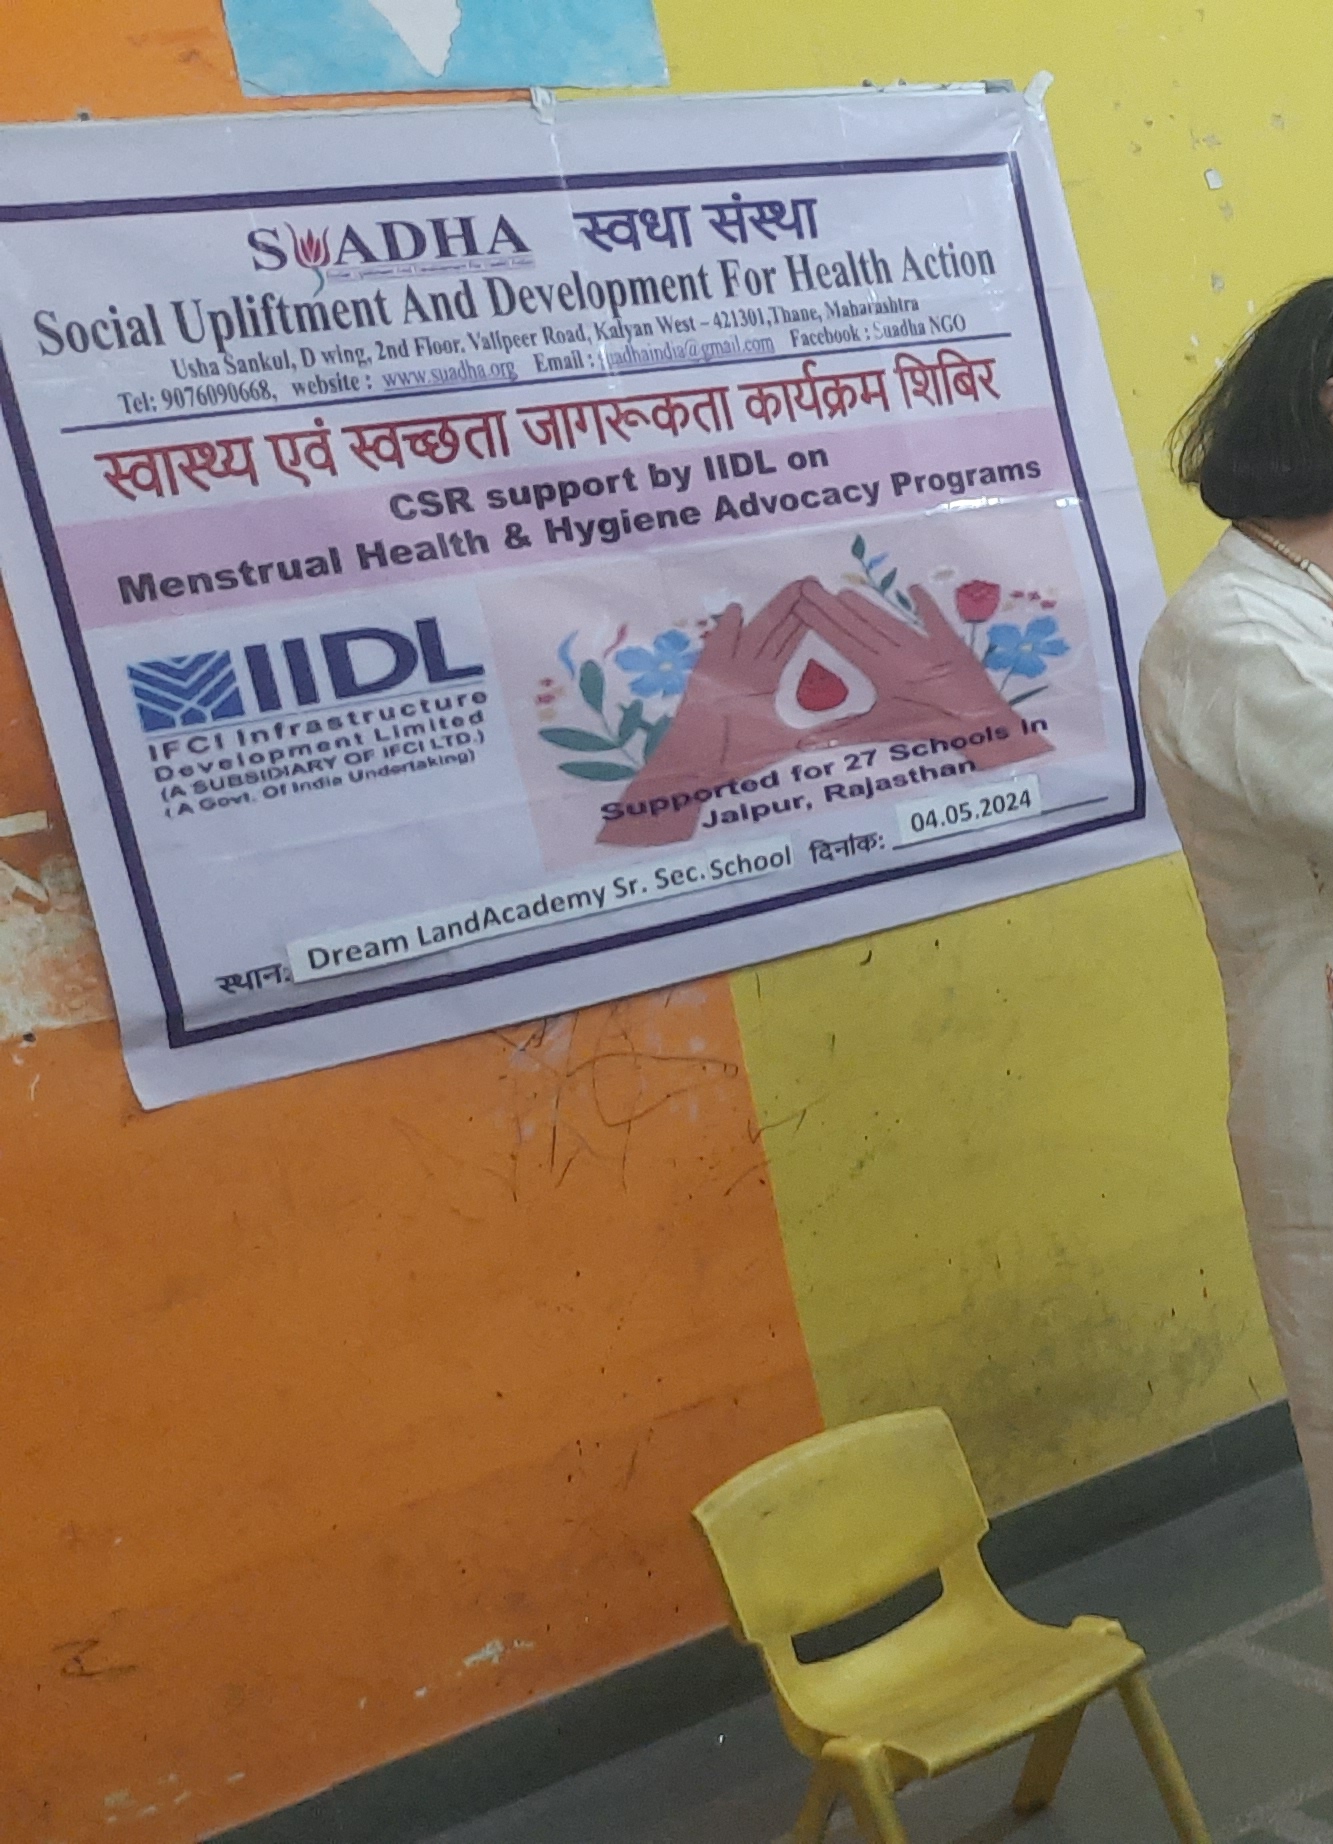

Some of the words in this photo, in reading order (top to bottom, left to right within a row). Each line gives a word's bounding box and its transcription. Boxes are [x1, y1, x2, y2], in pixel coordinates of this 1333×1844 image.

[573, 205, 692, 253] स्वधा
[701, 192, 818, 244] संस्था
[33, 303, 166, 356] Social
[170, 287, 393, 353] Upliftment
[403, 278, 479, 325] And
[483, 264, 713, 319] Development
[717, 258, 777, 298] For
[783, 248, 893, 293] Health
[902, 241, 996, 282] Action
[170, 356, 221, 380] Usha
[223, 349, 297, 376] Sankul,
[300, 347, 316, 368] D
[320, 344, 373, 369] wing,
[374, 338, 410, 361] 2nd
[541, 322, 593, 345] Road,
[593, 318, 654, 343] Kalyan
[655, 314, 697, 334] West
[824, 296, 920, 319] Maharashtra
[117, 392, 158, 415] Tel:
[161, 379, 278, 410] 9076090668,
[291, 372, 361, 396] website
[381, 359, 518, 388] www.suadha.org
[533, 349, 584, 373] Email
[789, 324, 861, 348] Facebook
[872, 318, 926, 340] Suadha
[928, 313, 966, 335] NGO
[94, 436, 260, 501] स्वास्थ्य
[264, 417, 338, 487] एवं
[341, 410, 510, 471] स्वच्छता
[515, 385, 735, 450] जागरूकता
[737, 359, 891, 426] कार्यक्रम
[893, 348, 1001, 409] शिबिर
[389, 485, 475, 521] CSR
[486, 467, 639, 510] support
[647, 463, 692, 493] by
[703, 449, 777, 481] IIDL
[787, 448, 829, 471] on
[117, 547, 344, 606] Menstrual
[356, 527, 490, 571] Health
[504, 522, 532, 550] &
[544, 504, 702, 547] Hygiene
[714, 480, 880, 522] Advocacy
[890, 459, 1042, 497] Programs
[244, 616, 485, 713] IIDL
[149, 732, 224, 762] IFCI
[237, 691, 487, 747] Infrastructure
[154, 732, 364, 783] Development
[374, 709, 484, 742] Limited
[192, 754, 337, 795] SUBSIDIARY
[344, 748, 375, 765] OF
[383, 740, 425, 759] IFCI
[292, 774, 343, 793] India
[348, 748, 475, 783] Undertaking)
[600, 768, 780, 822] Supported
[791, 761, 834, 784] for
[843, 749, 877, 773] 27
[888, 725, 1010, 761] Schools
[701, 793, 813, 829] Jaipur,
[824, 756, 977, 802] Rajasthan
[307, 933, 409, 970] Dream
[614, 875, 648, 899] Sr.
[654, 865, 706, 890] Sec.
[710, 844, 793, 881] School
[910, 789, 1032, 833] 04.05.2024
